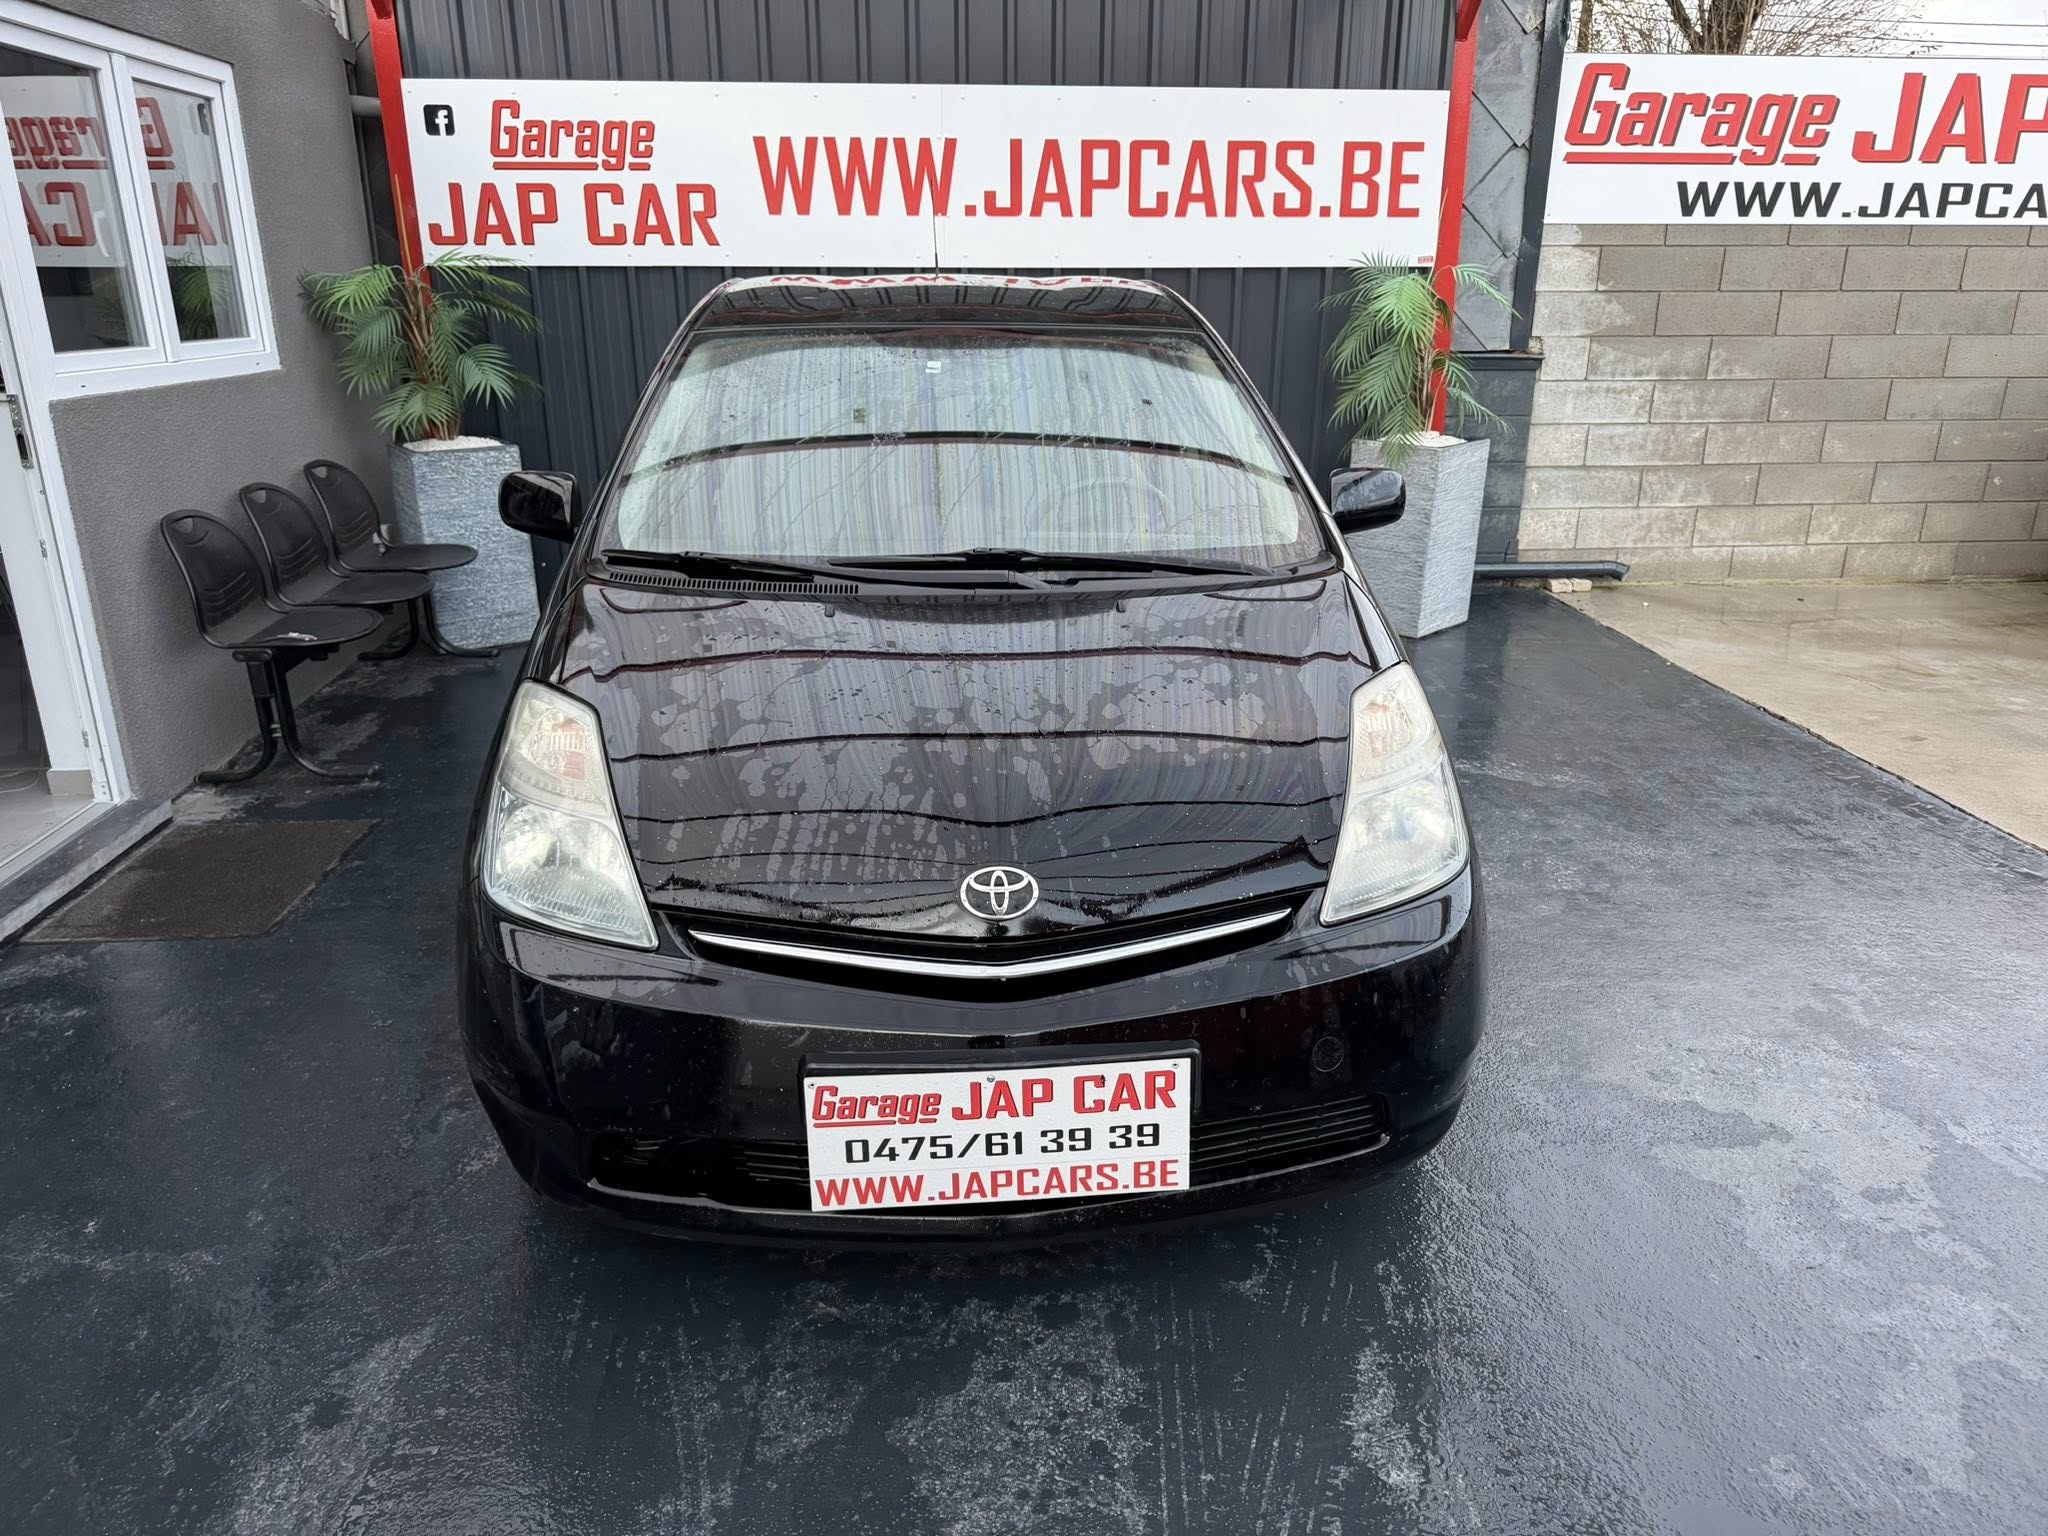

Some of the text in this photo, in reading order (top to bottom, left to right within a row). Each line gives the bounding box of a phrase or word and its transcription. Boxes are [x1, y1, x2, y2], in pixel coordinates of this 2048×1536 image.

[490, 100, 656, 171] Garage
[1563, 62, 2048, 166] Garage JAP
[752, 135, 1426, 219] WWW.JAPCARS.BE
[1677, 181, 2048, 219] WWW.JAPCA
[428, 182, 721, 246] JAP CAR
[812, 1070, 1177, 1127] Garage JAP CAR
[845, 1123, 1161, 1164] 0475/61 39 39
[815, 1160, 1180, 1208] WWW.JAPCARS.BE
